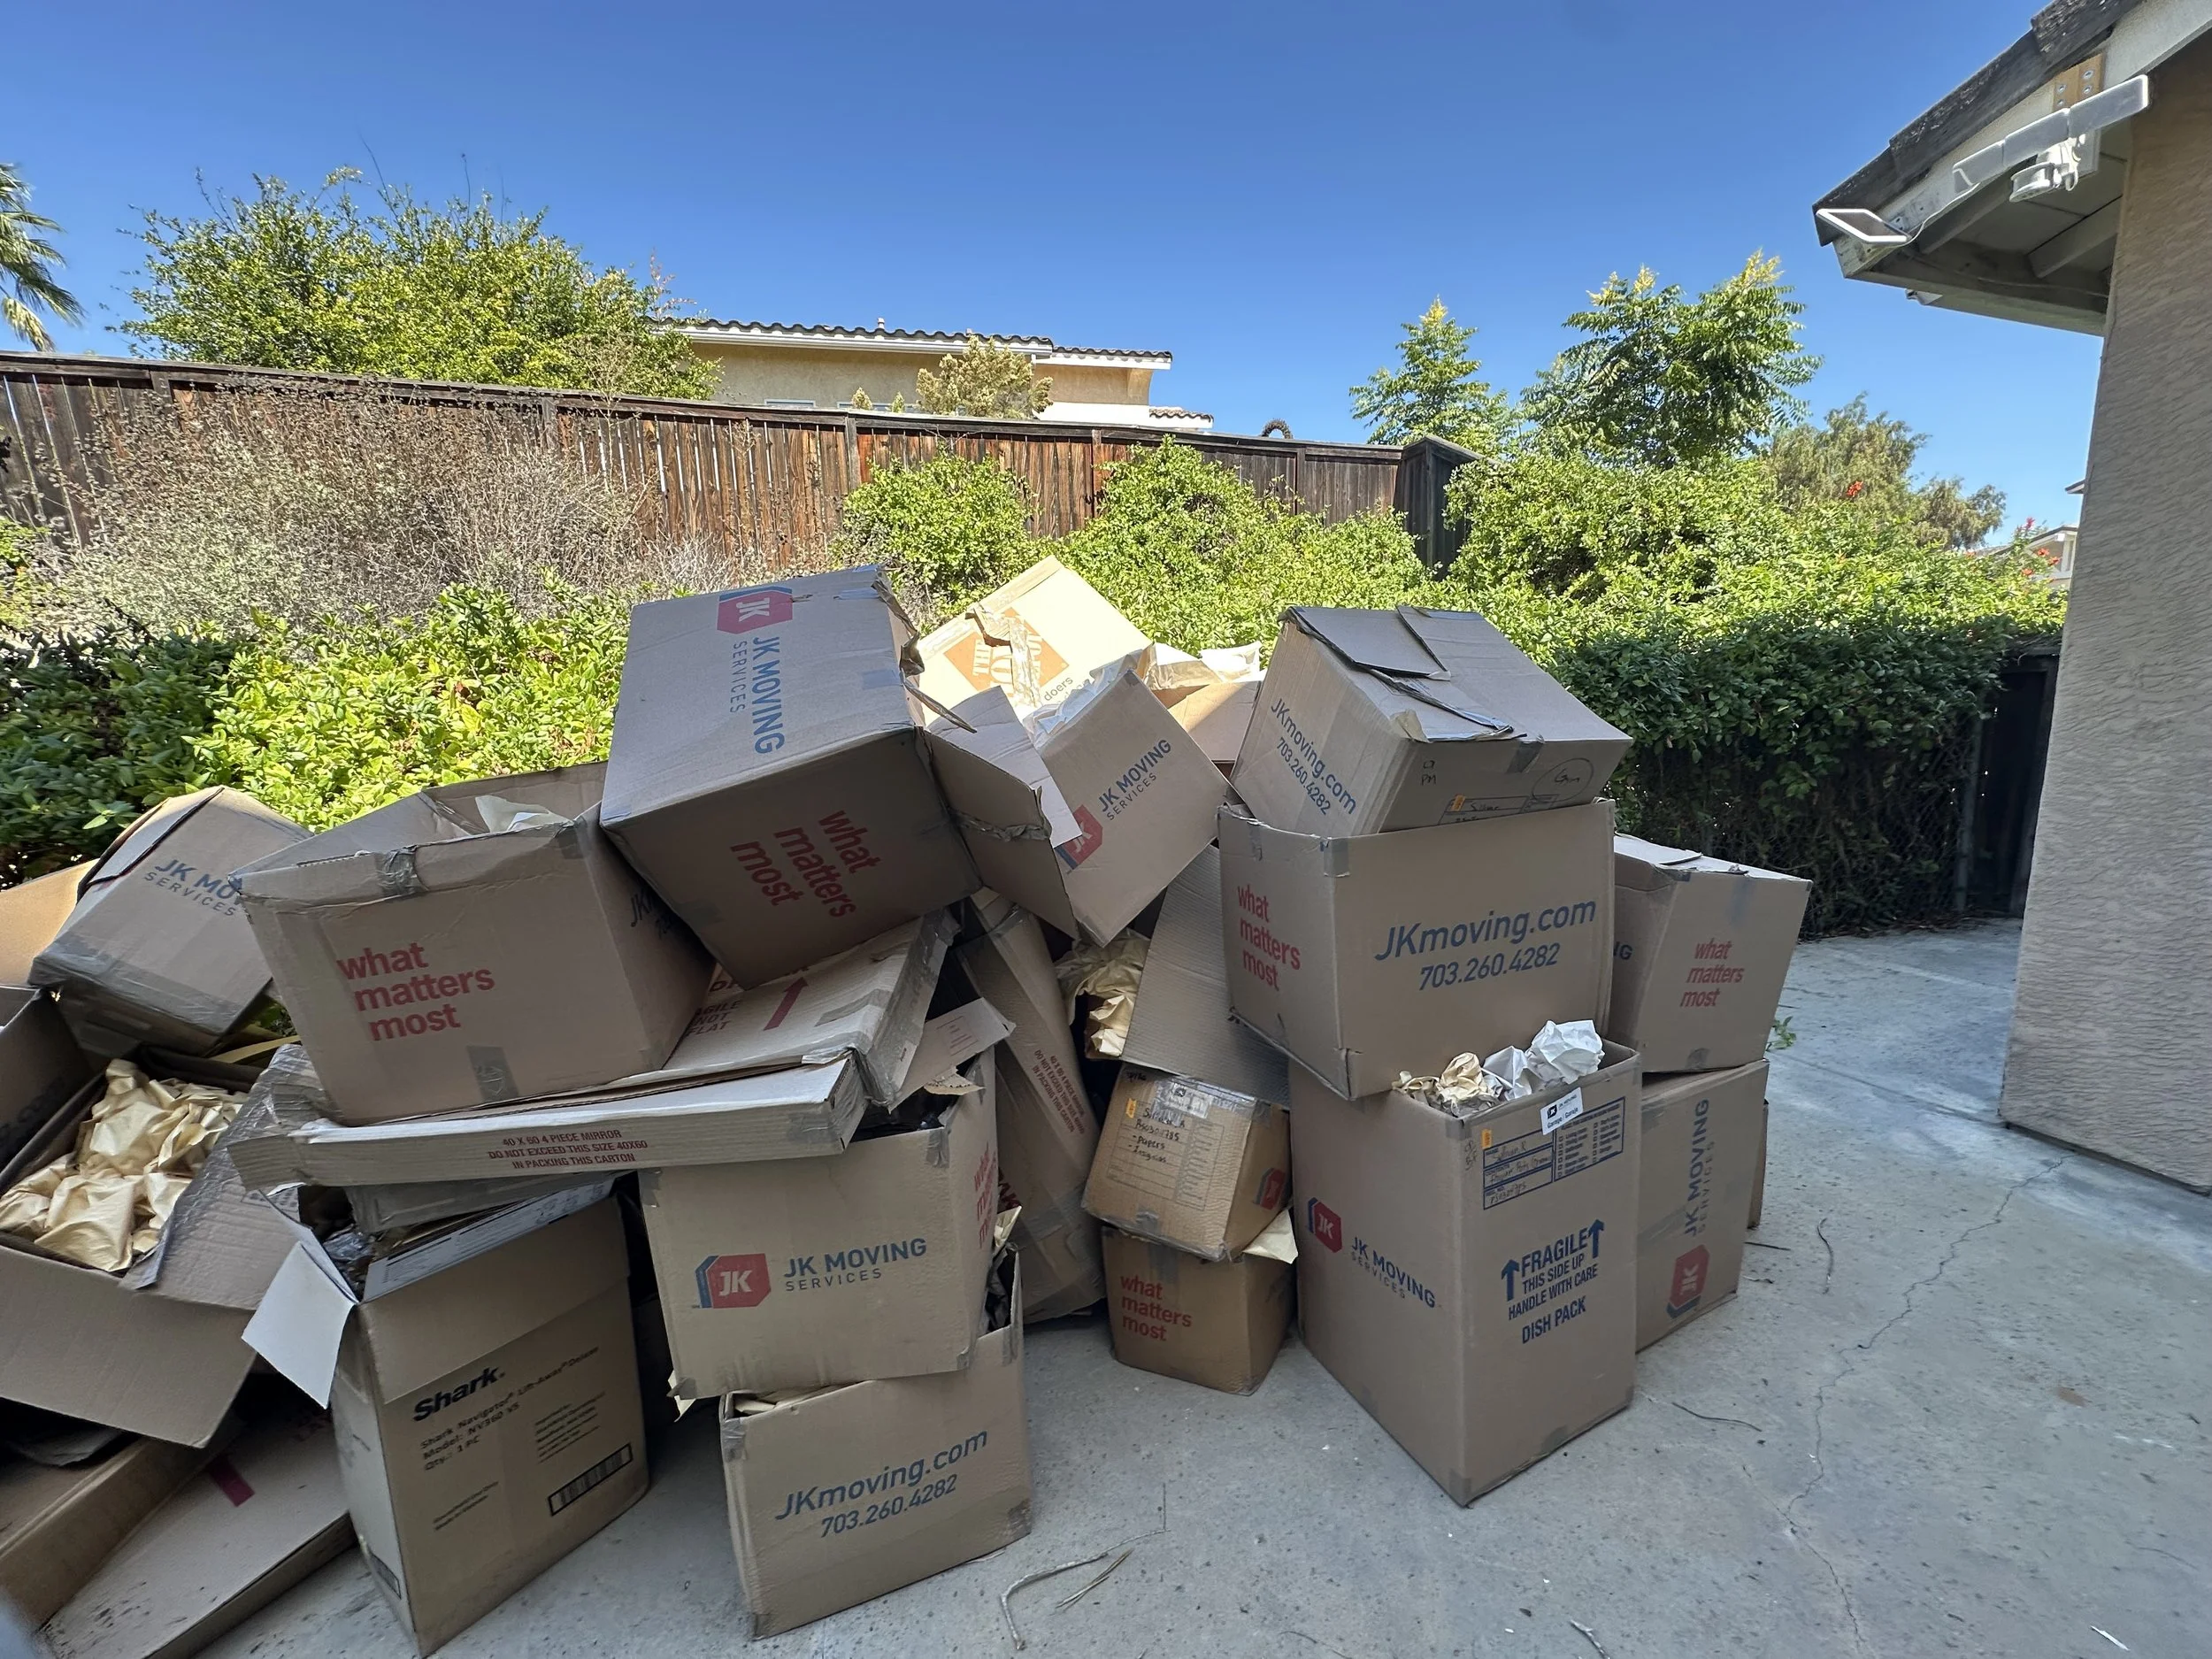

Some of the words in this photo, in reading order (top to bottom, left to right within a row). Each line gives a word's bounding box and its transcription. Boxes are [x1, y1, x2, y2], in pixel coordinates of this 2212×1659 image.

[735, 597, 770, 622] JK
[752, 636, 780, 661] JK
[729, 641, 748, 713] SERVICES
[1043, 676, 1073, 702] doers
[752, 659, 785, 755] MOVING
[1098, 787, 1119, 812] JK
[1116, 739, 1171, 794] MOVING
[1271, 698, 1356, 815] JKmoving.com
[1277, 736, 1331, 816] 703.260.4282
[1106, 772, 1157, 821] SERVICES
[818, 810, 882, 874] what
[154, 859, 196, 882] JK
[730, 841, 804, 907] most
[773, 827, 856, 918] matters
[144, 871, 236, 917] SERVICES
[1237, 884, 1270, 923] what
[1240, 918, 1301, 971] matters
[1374, 900, 1596, 961] JKmoving.com
[1694, 938, 1732, 960] what
[336, 941, 429, 980] what
[1242, 949, 1279, 992] most
[1418, 942, 1561, 991] 703.260.4282
[1686, 964, 1745, 984] matters
[355, 969, 495, 1012] matters
[694, 1000, 741, 1016] AGILE
[1679, 987, 1721, 1007] most
[368, 1003, 461, 1041] most
[1040, 1058, 1051, 1071] NOT
[488, 1150, 503, 1159] DO
[504, 1149, 525, 1158] NOT
[528, 1146, 566, 1156] EXCEED
[568, 1144, 591, 1153] THIS
[592, 1142, 615, 1152] SIZE
[617, 1140, 649, 1150] 40X60
[503, 1138, 516, 1147] 40
[527, 1136, 540, 1145] 60
[541, 1135, 549, 1144] 4
[549, 1133, 578, 1143] PIECE
[581, 1129, 622, 1141] MIRROR
[1687, 1098, 1709, 1202] MOVING
[512, 1160, 524, 1169] IN
[526, 1156, 569, 1169] PACKING
[571, 1156, 594, 1165] THIS
[595, 1153, 636, 1164] CARTON
[1317, 1213, 1335, 1240] JK
[1685, 1205, 1700, 1237] JK
[784, 1256, 818, 1278] JK
[825, 1238, 927, 1272] MOVING
[1351, 1237, 1369, 1260] JK
[1372, 1249, 1436, 1309] MOVING
[1522, 1227, 1589, 1278] FRAGILE
[718, 1270, 753, 1296] JK
[786, 1268, 882, 1292] SERVICES
[1120, 1275, 1163, 1300] what
[1350, 1251, 1406, 1300] SERVICES
[1509, 1289, 1548, 1321] HANDLE
[1548, 1277, 1572, 1300] WITH
[1574, 1263, 1598, 1286] CARE
[1522, 1272, 1546, 1294] THIS
[1547, 1260, 1570, 1283] SIDE
[1571, 1253, 1585, 1271] UP
[1122, 1296, 1193, 1327] matters
[1122, 1315, 1167, 1341] most
[1522, 1314, 1551, 1344] DISH
[1555, 1295, 1586, 1327] PACK
[775, 1430, 988, 1521] JKmoving.com
[820, 1473, 958, 1539] 703.260.4282
